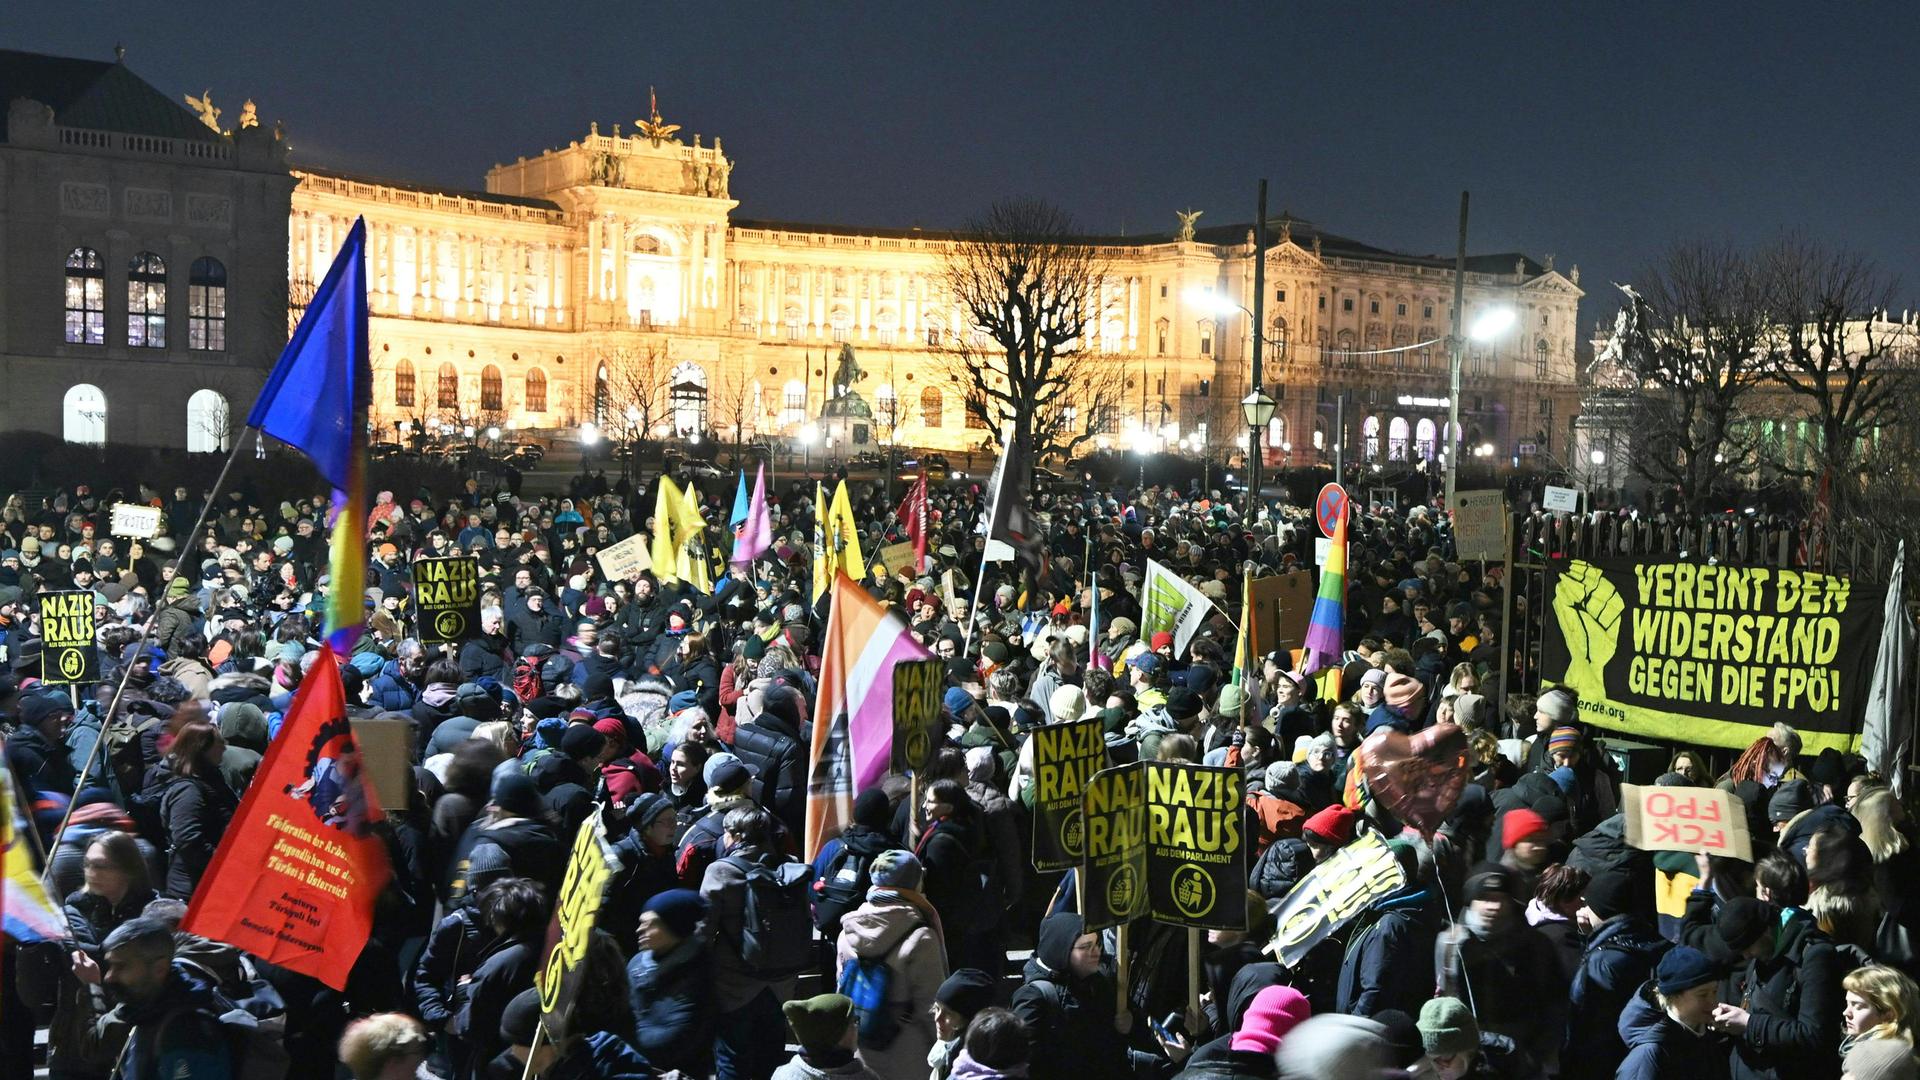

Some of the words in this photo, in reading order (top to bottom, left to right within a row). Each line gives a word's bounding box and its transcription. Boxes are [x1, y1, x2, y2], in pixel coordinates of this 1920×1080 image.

[416, 559, 477, 582] NAZIS
[417, 578, 477, 604] RAUS
[1635, 563, 1769, 612] VEREINT
[1776, 569, 1850, 614] DEN
[41, 593, 93, 618] NAZIS
[43, 615, 94, 642] RAUS
[1633, 608, 1840, 665] WIDERSTAND
[895, 661, 942, 689] NAZIS
[1629, 655, 1714, 703] GEGEN
[1721, 665, 1764, 708] DIE
[1773, 666, 1840, 713] FPÖ!
[895, 687, 941, 724] RAUS
[1577, 700, 1625, 721] ende.org
[1038, 721, 1104, 764] NAZIS
[1087, 768, 1146, 816] NAZI
[1148, 766, 1240, 811] NAZIS
[1089, 806, 1146, 857] RAU
[1148, 804, 1240, 854] RAUS
[1653, 823, 1727, 848] FCK
[326, 863, 341, 877] aus
[1155, 847, 1169, 857] AUS
[1170, 849, 1185, 860] DEM
[1185, 851, 1233, 865] PARLAMENT
[306, 869, 348, 899] Österreich
